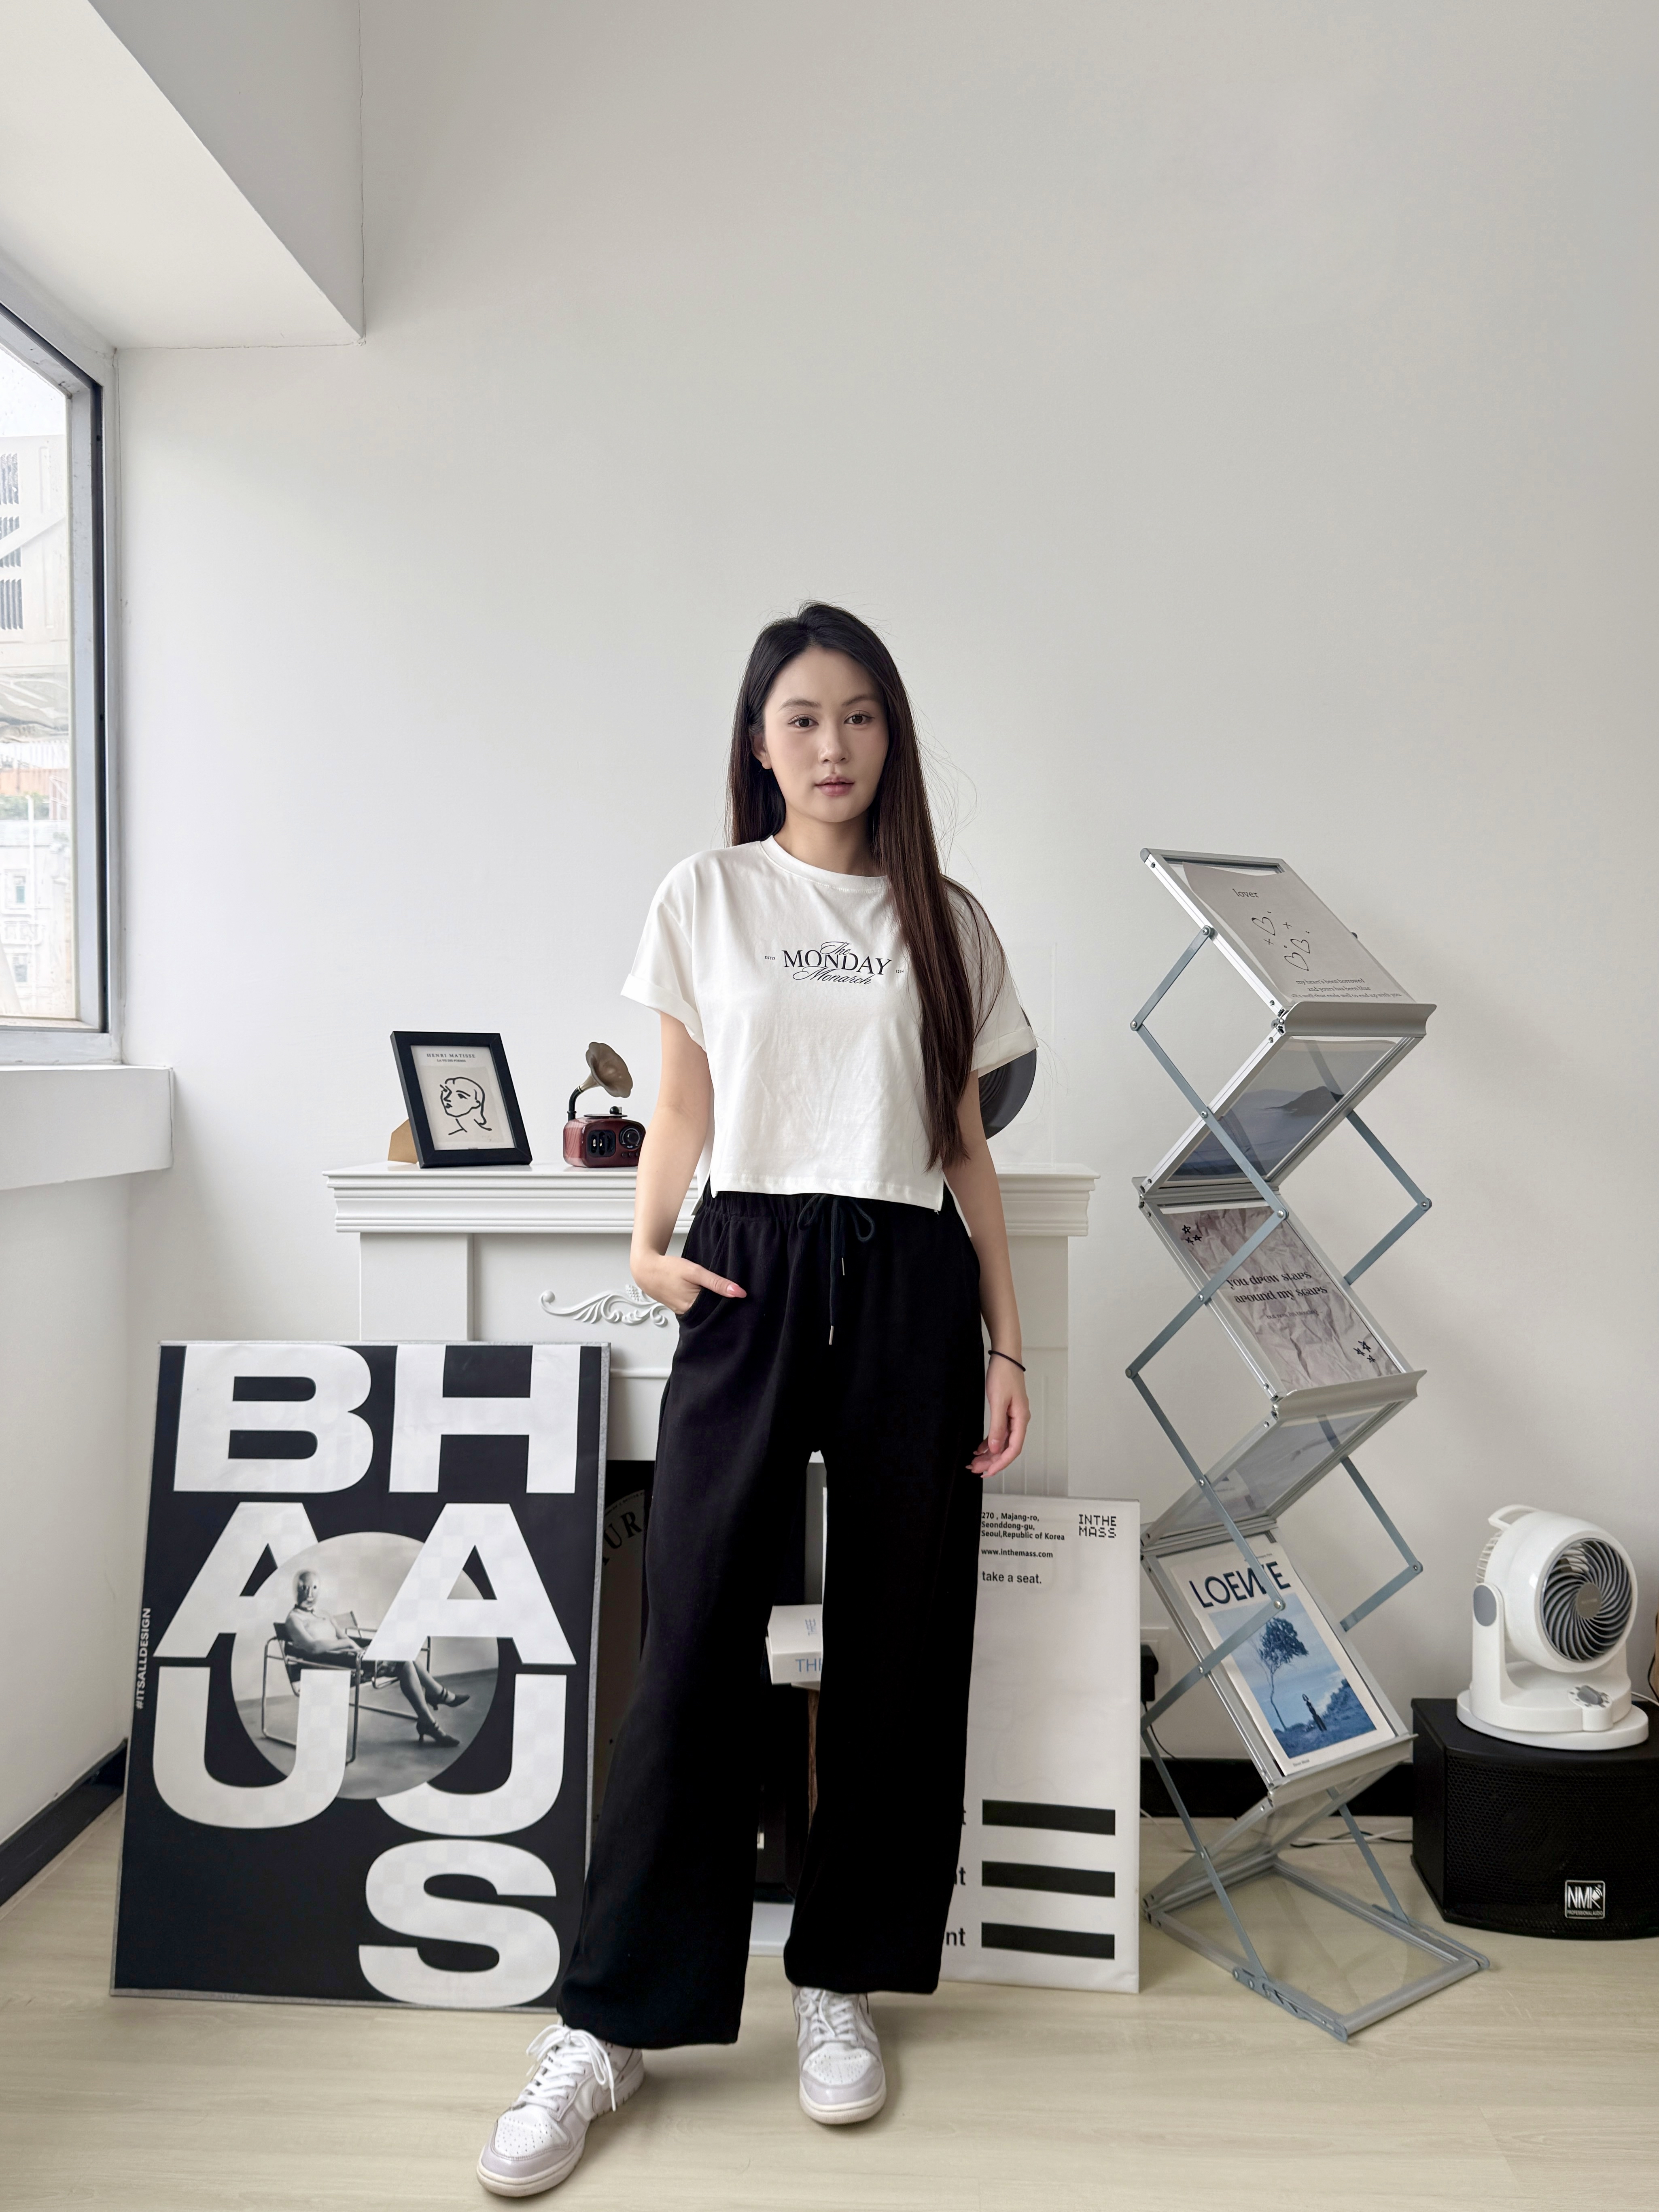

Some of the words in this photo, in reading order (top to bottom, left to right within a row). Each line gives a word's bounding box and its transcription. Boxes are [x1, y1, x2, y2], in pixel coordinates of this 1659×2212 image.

[1232, 888, 1259, 898] lover
[820, 942, 851, 955] The
[781, 950, 892, 975] MONDAY
[793, 966, 875, 985] Monarch
[1226, 1279, 1249, 1290] you
[1249, 1275, 1279, 1285] drew
[1281, 1271, 1312, 1282] stars
[1234, 1290, 1277, 1303] around
[1276, 1289, 1296, 1301] my
[1295, 1285, 1328, 1297] scars
[1001, 1512, 1040, 1522] Majang-ro,
[1078, 1514, 1117, 1527] INTHE
[981, 1521, 1035, 1531] Seonddong-gu,
[1078, 1526, 1117, 1538] MASS
[1044, 1532, 1065, 1540] Korea
[981, 1548, 1053, 1558] www.inthemass.com
[982, 1571, 1004, 1582] take
[1008, 1574, 1013, 1582] a
[1016, 1574, 1042, 1584] seat.
[1189, 1561, 1291, 1608] LOEWE
[135, 1607, 151, 1710] #ITSALLDESIGN
